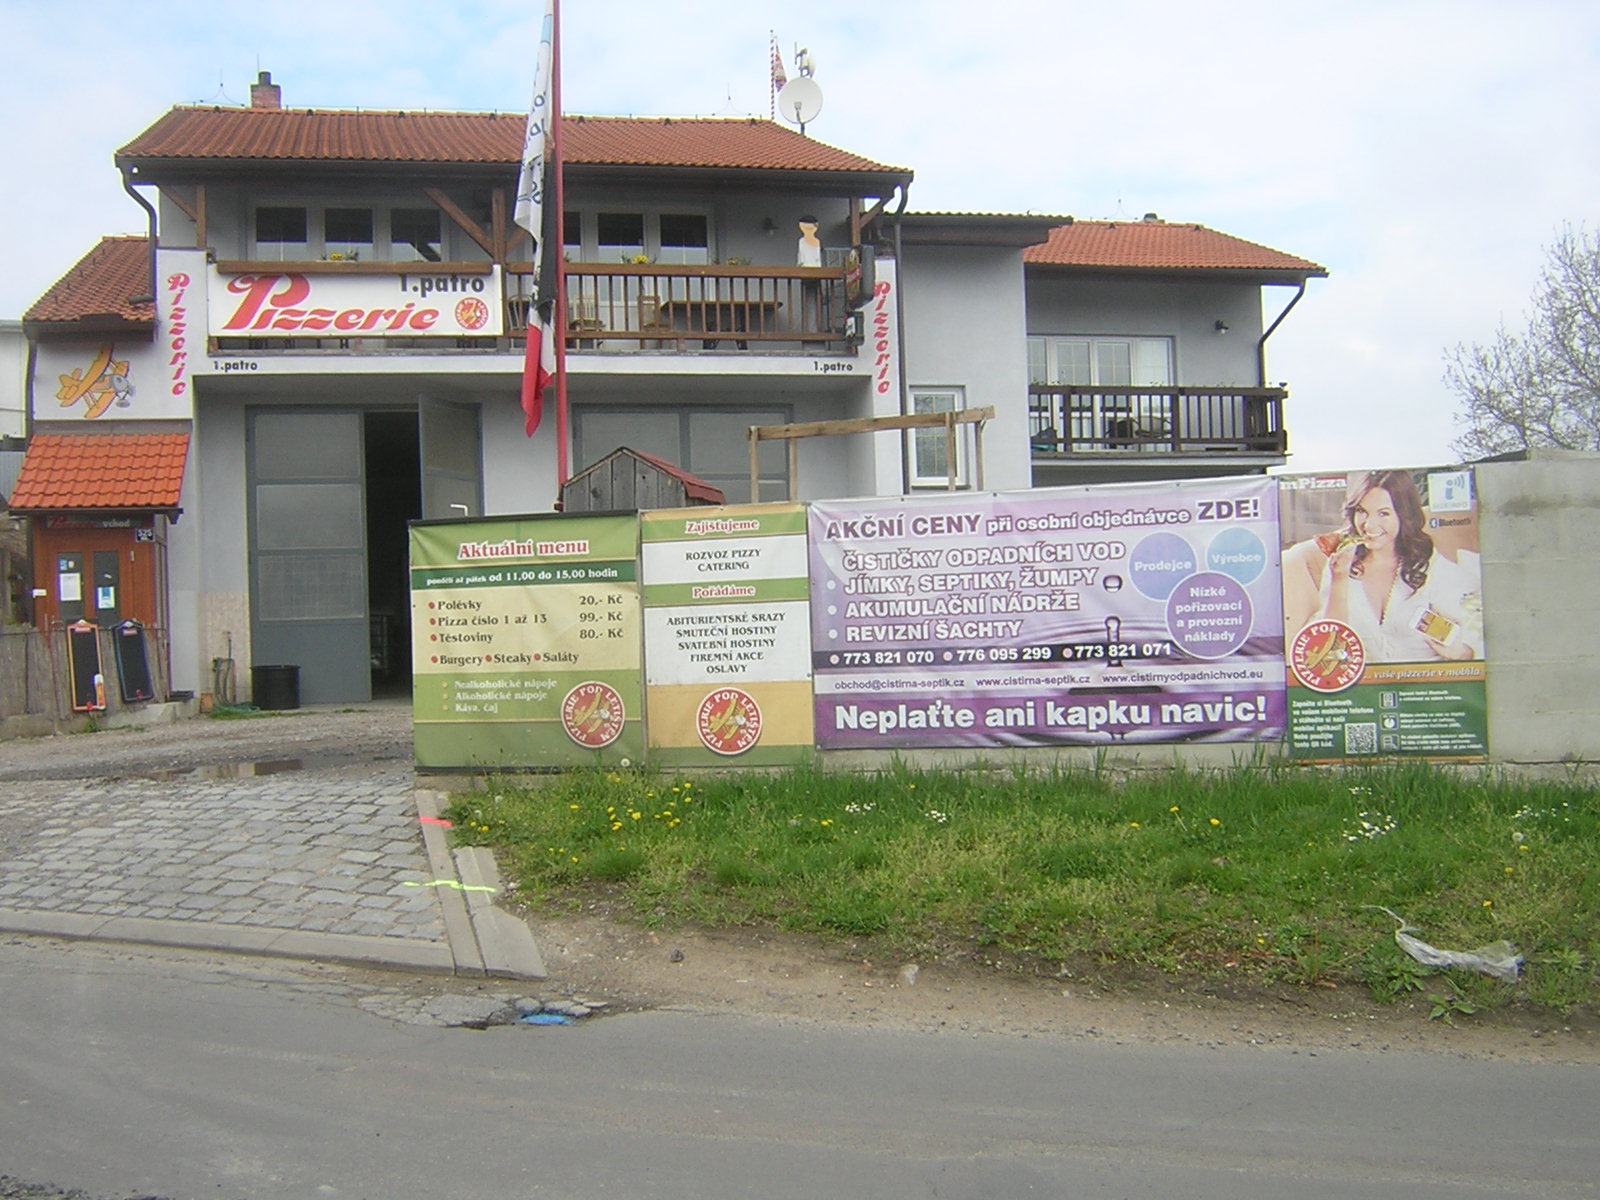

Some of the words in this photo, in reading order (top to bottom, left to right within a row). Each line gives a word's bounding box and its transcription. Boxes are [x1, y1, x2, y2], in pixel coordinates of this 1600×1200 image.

[399, 274, 485, 298] 1.patro
[222, 273, 440, 331] Pizzerie
[167, 272, 191, 396] Pizzerie
[873, 281, 891, 393] Pizzerie
[213, 360, 258, 373] 1.patro
[814, 361, 853, 373] 1.patro
[826, 515, 904, 539] AKČNÍ
[912, 515, 981, 536] CENY
[986, 516, 1011, 535] při
[1016, 511, 1078, 531] osobní
[1082, 508, 1192, 530] objednávce
[1197, 499, 1260, 520] ZDE!
[687, 520, 759, 534] Zajišťujeme
[459, 541, 532, 558] Aktuální
[539, 540, 588, 554] menu
[686, 551, 728, 561] ROZVOZ
[731, 549, 761, 558] PIZZY
[843, 547, 942, 571] ČISTIČKY
[946, 541, 1073, 566] ODPADNÍCH
[1078, 541, 1126, 561] VOD
[697, 561, 750, 572] CATERING
[1134, 560, 1192, 572] Prodejce
[1211, 553, 1262, 565] Výrobce
[488, 573, 502, 582] od
[538, 570, 552, 580] do
[588, 567, 618, 578] hodin
[844, 573, 914, 596] JÍMKY,
[919, 571, 1015, 592] SEPTIKY,
[1020, 566, 1099, 588] ŽUMPY
[693, 585, 755, 598] Pořádáme
[1190, 586, 1227, 598] Nízké
[437, 600, 482, 611] Polévky
[607, 594, 623, 604] Kč
[845, 593, 986, 618] AKUMULAČNÍ
[991, 589, 1080, 613] NÁDRŽE
[1175, 600, 1242, 615] pořizovací
[438, 616, 468, 626] Pizza
[471, 615, 499, 625] číslo
[503, 615, 509, 624] 1
[514, 614, 528, 624] až
[533, 613, 547, 624] 13
[607, 611, 623, 621] Kč
[667, 611, 749, 626] ABITURIENTSKÉ
[751, 612, 786, 622] SRAZY
[1176, 619, 1184, 627] a
[1188, 614, 1242, 628] provozní
[438, 632, 494, 644] Těstoviny
[607, 628, 624, 638] Kč
[676, 625, 728, 638] SMUTEČNÍ
[731, 626, 778, 636] HOSTINY
[846, 621, 930, 642] REVIZNÍ
[935, 619, 1023, 640] ŠACHTY
[1184, 631, 1235, 643] náklady
[1310, 624, 1339, 636] POD
[678, 639, 728, 650] SVATEBNÍ
[730, 638, 776, 648] HOSTINY
[1075, 645, 1104, 658] 773
[1108, 643, 1136, 657] 821
[1142, 642, 1171, 656] 071
[440, 654, 483, 667] Burgery
[494, 652, 532, 665] Steaky
[542, 651, 579, 664] Saláty
[690, 651, 734, 662] FIREMNÍ
[735, 651, 764, 661] AKCE
[843, 653, 871, 664] 773
[875, 652, 901, 664] 821
[906, 651, 935, 663] 070
[956, 649, 985, 662] 776
[990, 648, 1018, 661] 095
[1022, 647, 1052, 660] 299
[706, 664, 748, 674] OSLAVY
[524, 678, 557, 689] nápoje
[834, 677, 965, 690] obchod@cistirna-septik.cz
[975, 674, 1091, 688] www.cistirna-septik.cz
[514, 690, 547, 701] nápoje
[579, 685, 603, 696] POD
[714, 691, 738, 703] POD
[835, 700, 975, 734] Neplaťte
[985, 701, 1035, 728] ani
[1046, 699, 1150, 731] kapku
